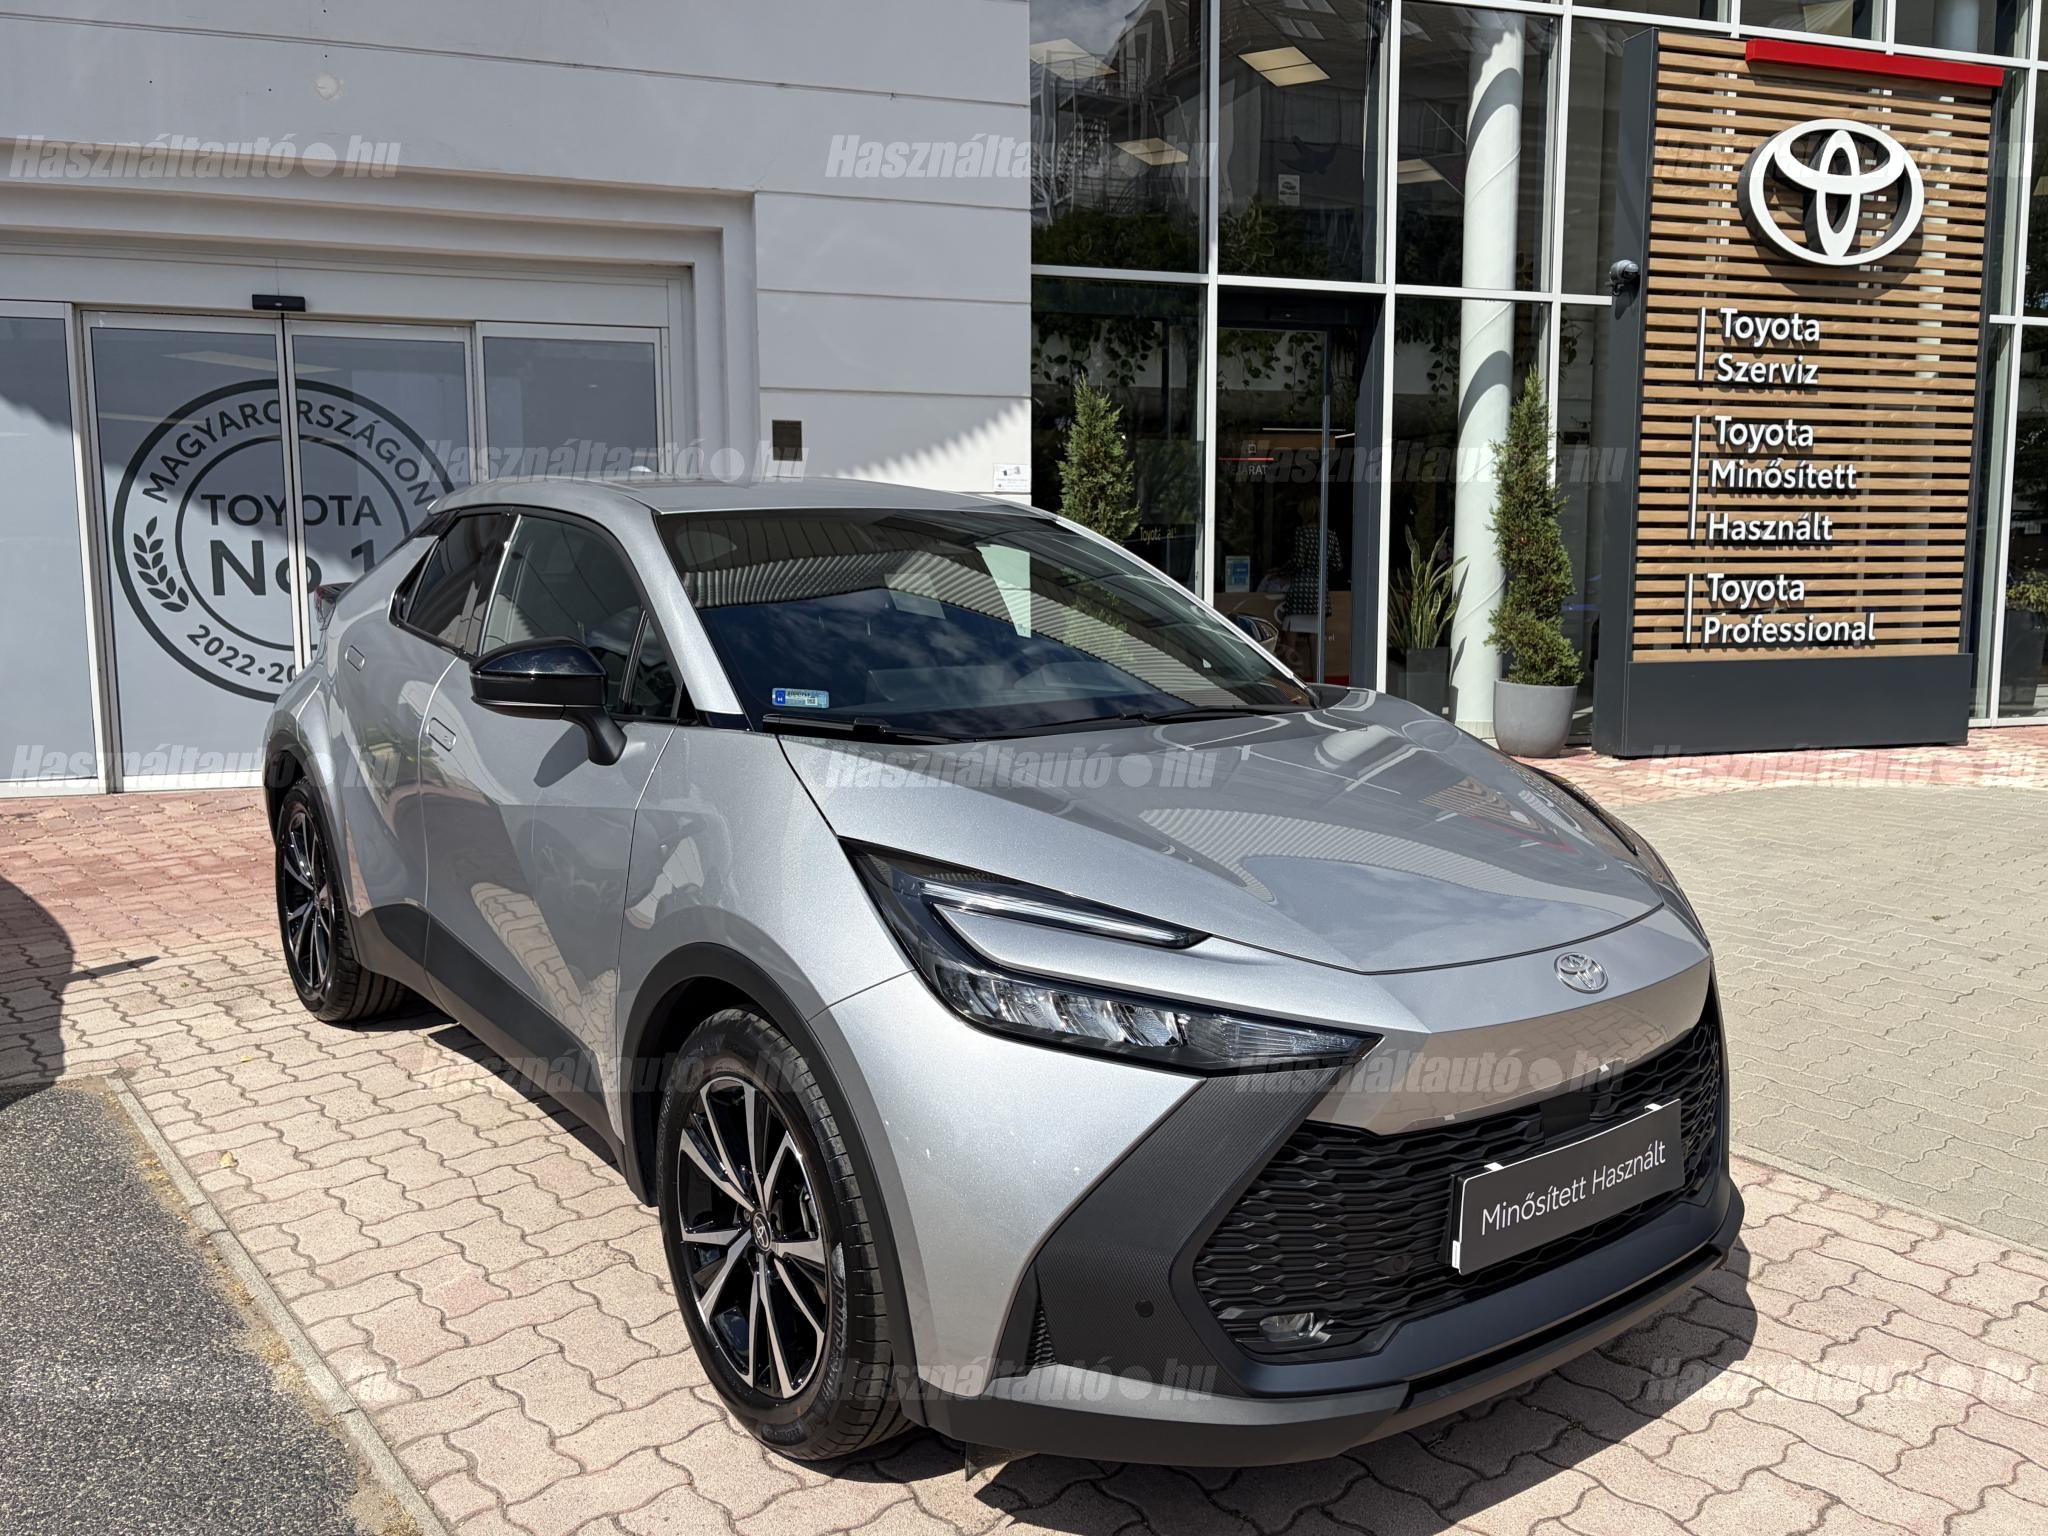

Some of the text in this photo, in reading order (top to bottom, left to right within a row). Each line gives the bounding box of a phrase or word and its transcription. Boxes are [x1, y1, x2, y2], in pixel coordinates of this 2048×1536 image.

[1720, 307, 1820, 347] Toyota
[1717, 353, 1818, 385] Szerviz
[1715, 415, 1814, 453] Toyota
[142, 400, 436, 506] MAGYARORSZÁGON
[1711, 457, 1857, 489] Minősített
[201, 494, 382, 527] TOYOTA
[1708, 511, 1833, 541] Használt
[1707, 573, 1805, 609] Toyota
[1704, 612, 1876, 644] Professional
[1481, 1140, 1666, 1236] Minősített Használt
